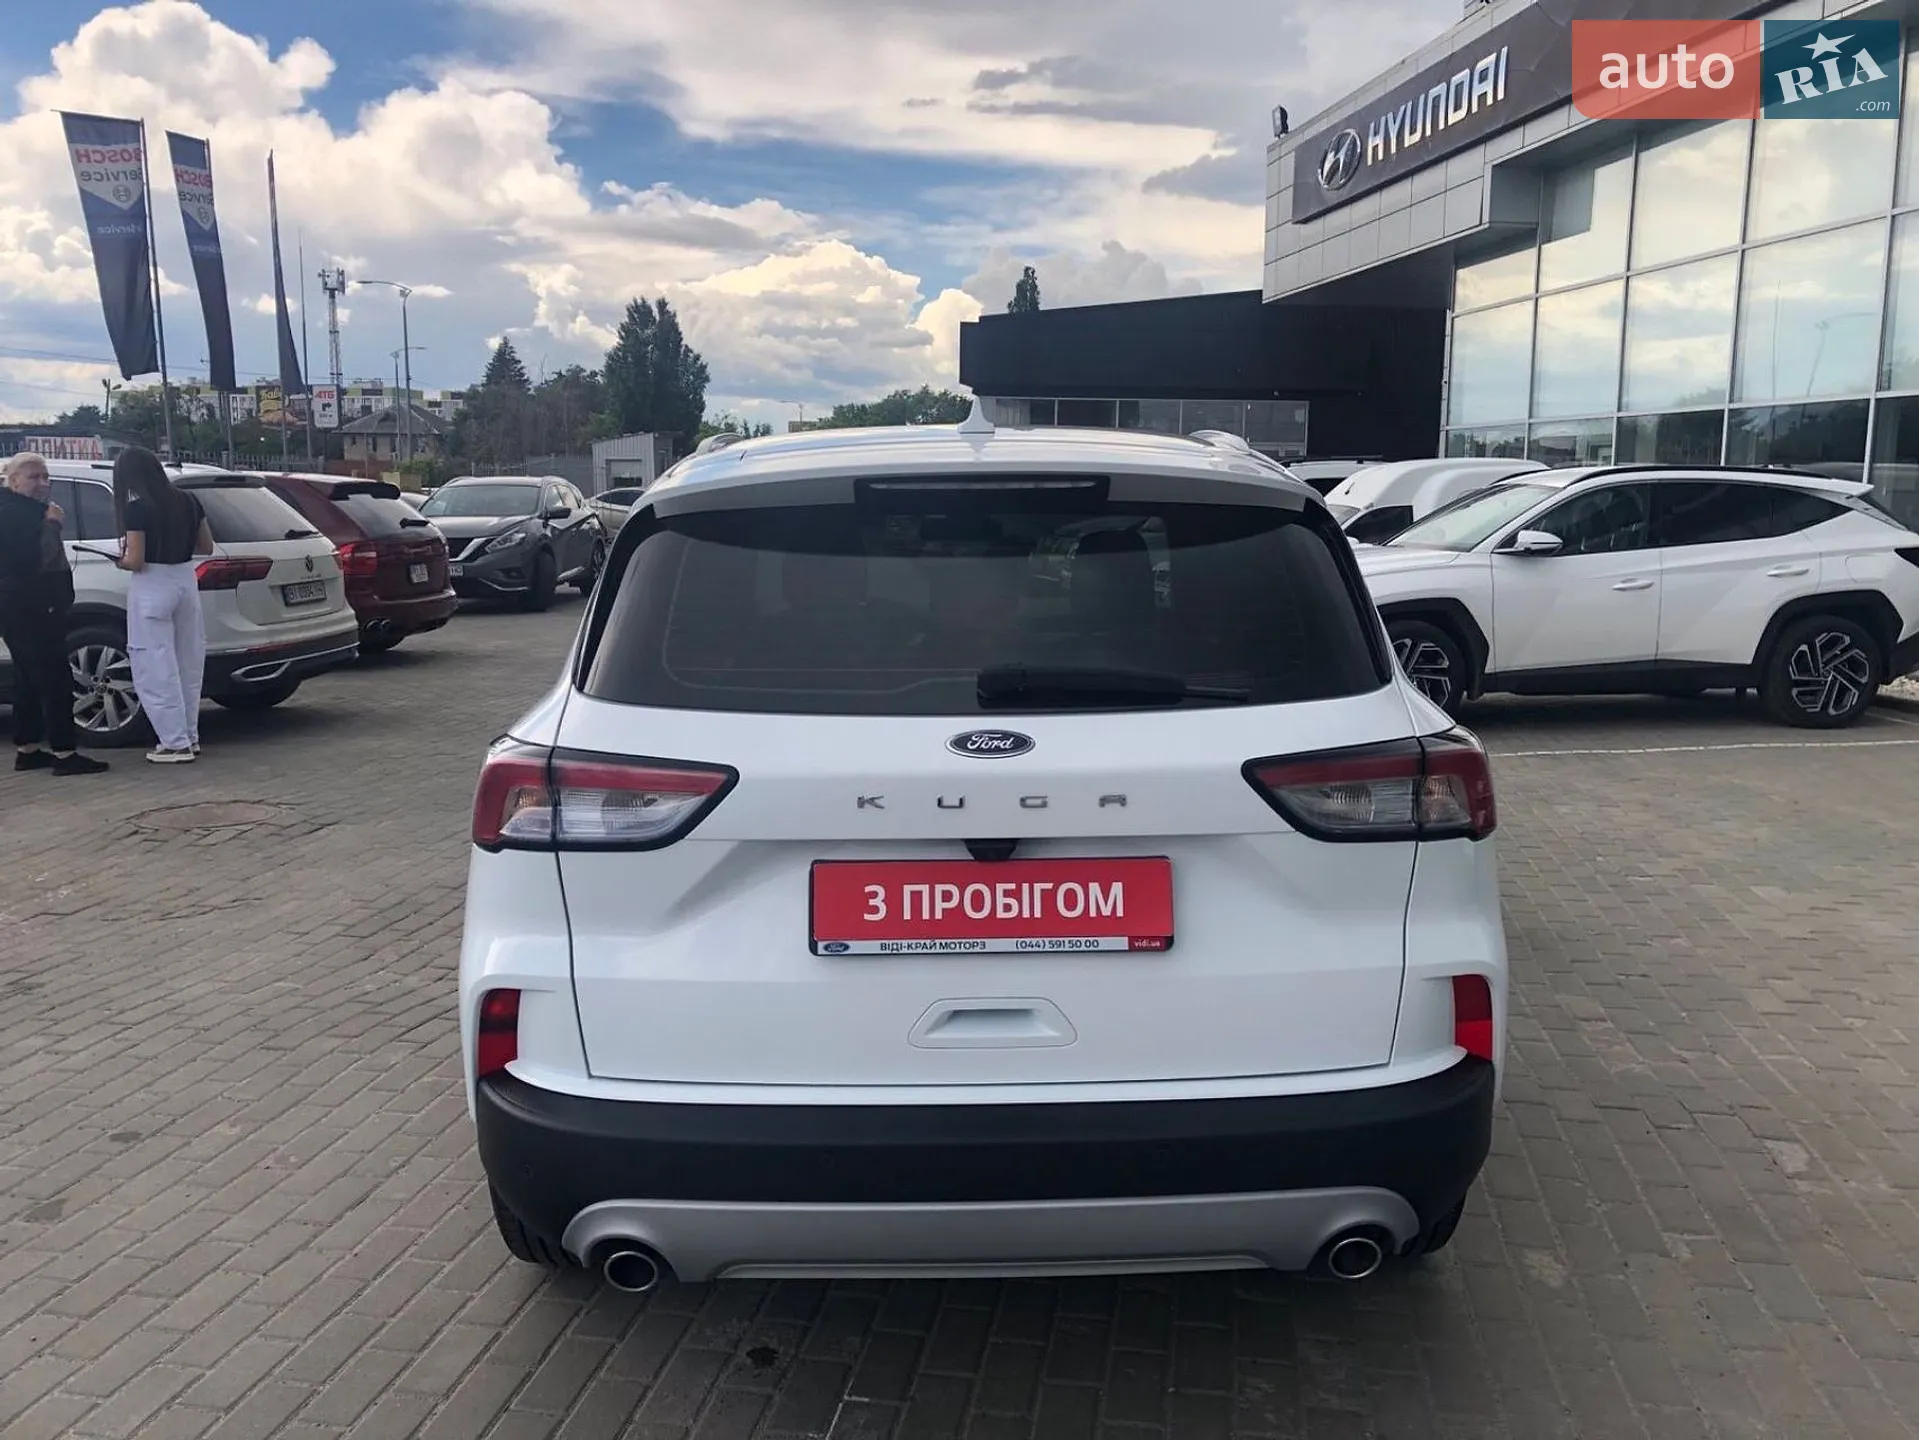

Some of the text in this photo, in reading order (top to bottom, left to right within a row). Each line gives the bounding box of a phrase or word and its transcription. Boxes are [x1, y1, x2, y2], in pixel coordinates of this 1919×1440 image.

[1366, 45, 1509, 167] HYUNDAI
[966, 733, 1015, 751] Ford
[856, 793, 1128, 810] KUGA
[902, 881, 1125, 921] ПРОБІГОМ
[879, 940, 987, 953] ВІДІ-КРАЙ МОТОРЗ
[1015, 939, 1100, 950] (044) 591 50 00
